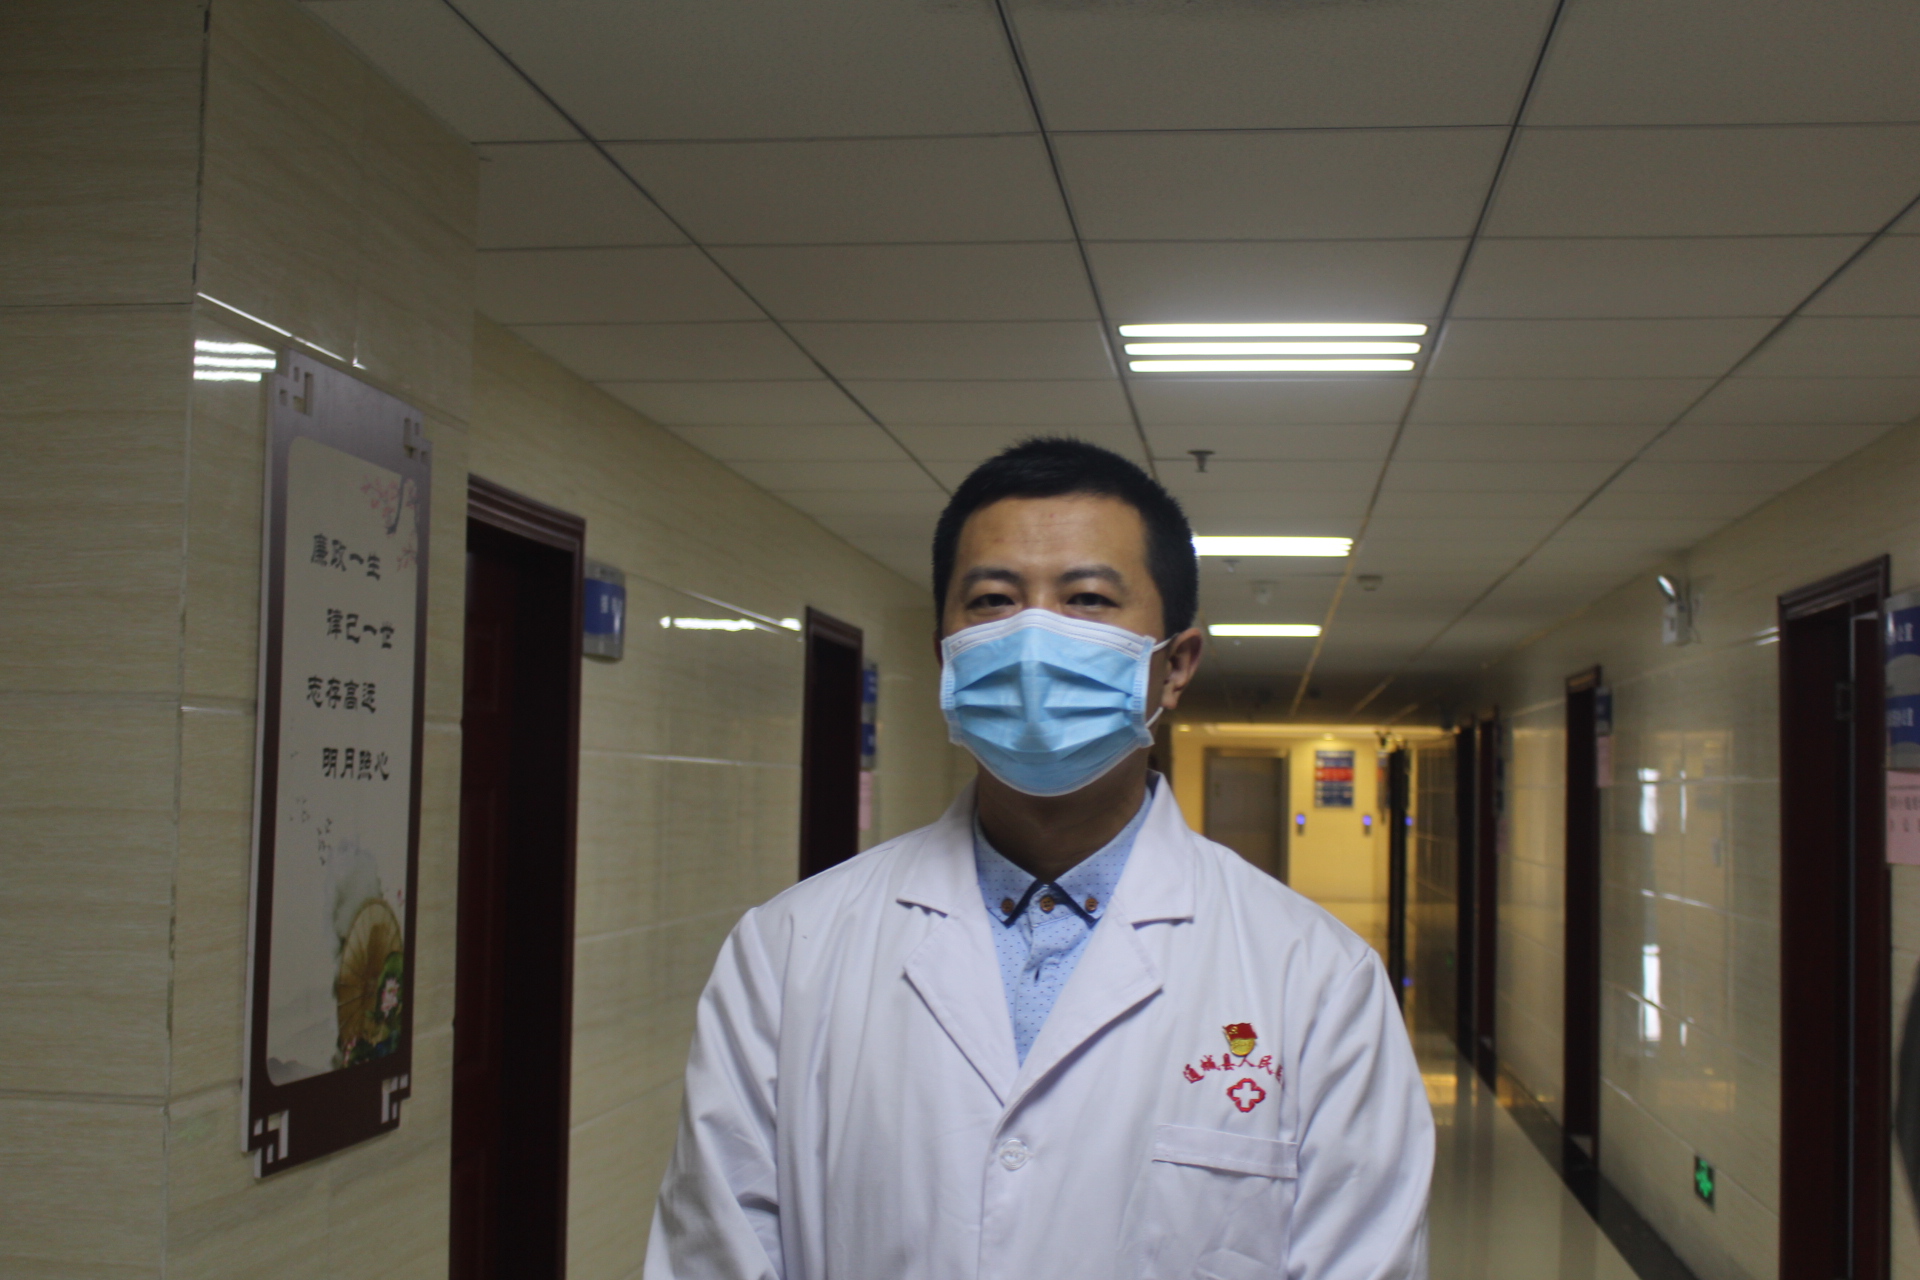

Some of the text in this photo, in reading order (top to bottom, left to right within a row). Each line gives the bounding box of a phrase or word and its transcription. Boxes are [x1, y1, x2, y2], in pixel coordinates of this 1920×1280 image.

[311, 534, 381, 580] 廉政一生
[327, 608, 394, 649] 律己一世
